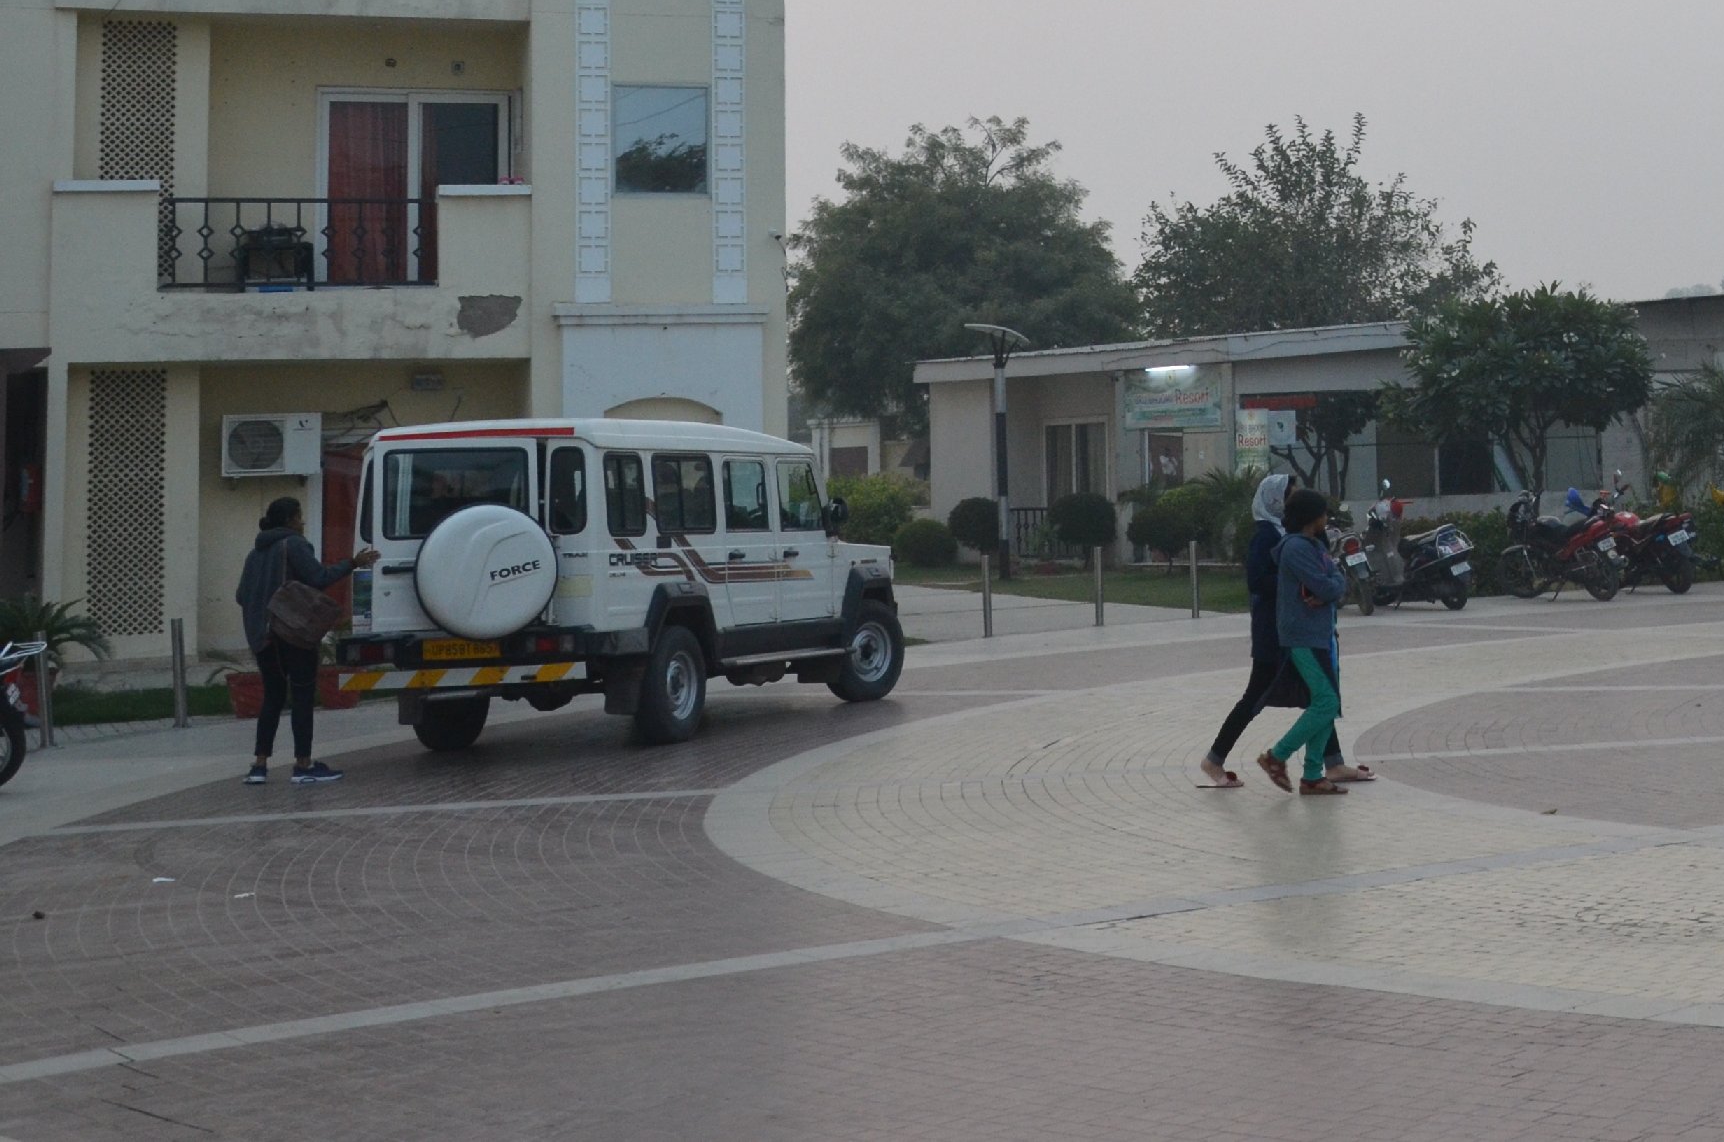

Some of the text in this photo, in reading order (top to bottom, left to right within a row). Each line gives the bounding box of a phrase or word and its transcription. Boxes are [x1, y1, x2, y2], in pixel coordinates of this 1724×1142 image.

[1174, 386, 1209, 405] Resort
[1237, 433, 1266, 447] Resort
[608, 552, 657, 566] CRUISER
[489, 559, 542, 581] FORCE
